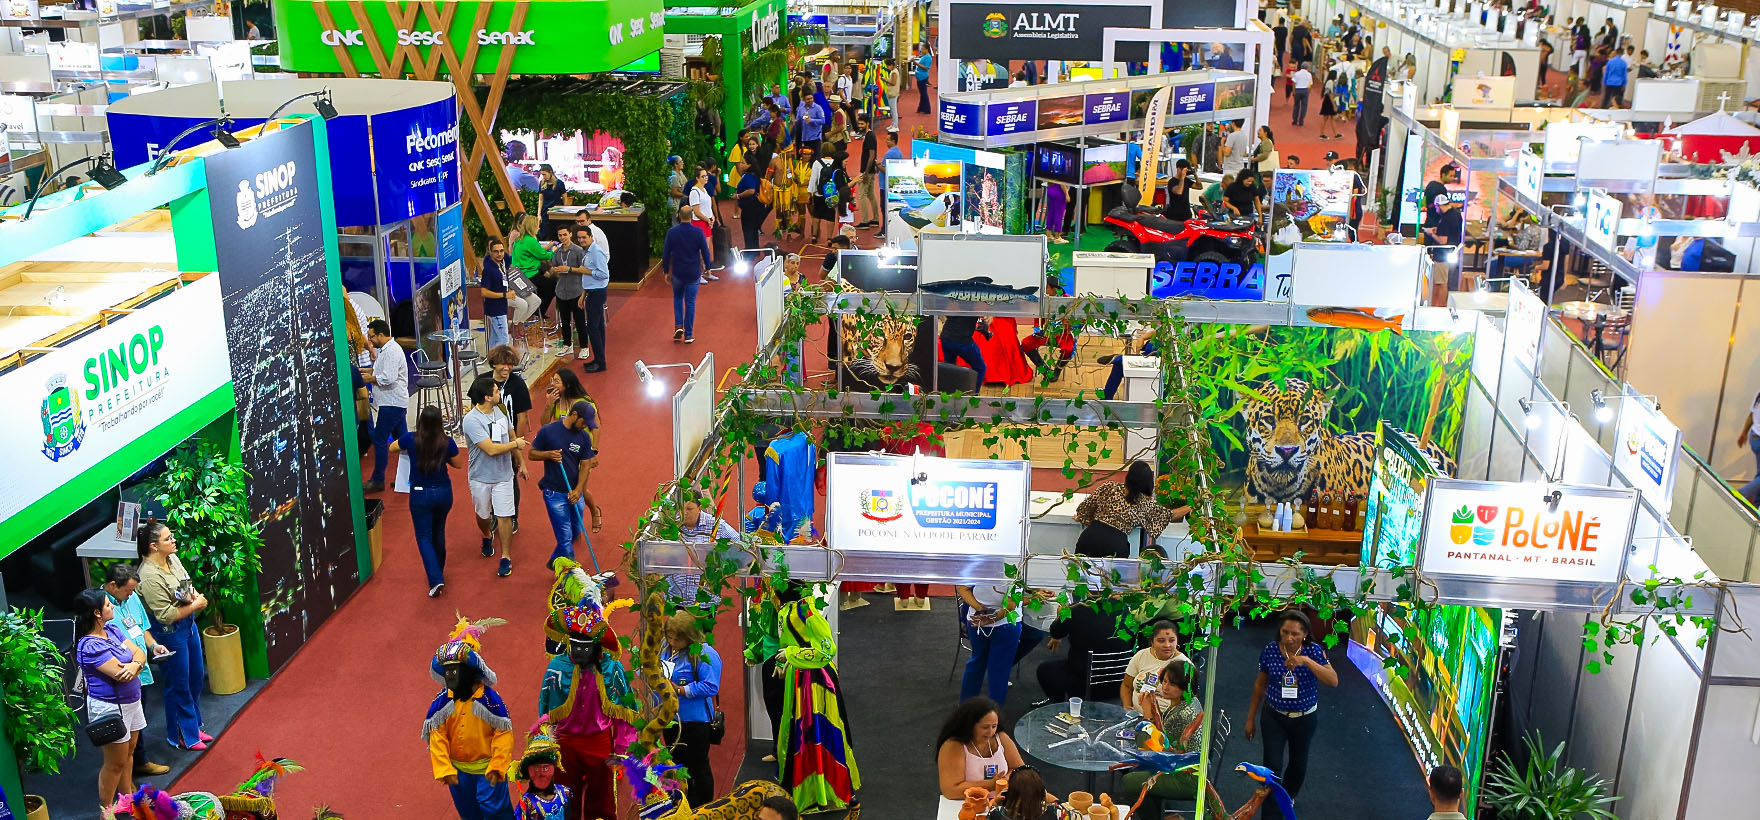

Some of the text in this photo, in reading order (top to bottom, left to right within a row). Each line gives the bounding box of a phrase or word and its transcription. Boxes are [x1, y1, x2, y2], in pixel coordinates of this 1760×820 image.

[1013, 12, 1080, 31] ALMT
[321, 28, 536, 46] CNC Sesc Senac
[609, 22, 624, 46] CNC
[630, 18, 645, 38] Sesc
[1013, 31, 1079, 40] Assembleia Legislativa
[966, 74, 994, 84] ALMT
[1179, 93, 1207, 105] SEBRAE
[1092, 102, 1122, 114] SEBRAE
[995, 112, 1028, 125] SEBRAE
[6, 122, 24, 130] ravel
[408, 160, 425, 172] CNC
[255, 161, 296, 199] SINOP
[258, 186, 298, 211] PREFEITURA
[84, 324, 164, 401] SINOP
[88, 367, 170, 422] PREFEITURA
[911, 483, 996, 510] POCONÉ
[915, 509, 992, 519] PREFEITURA MUNICIPAL
[925, 517, 952, 525] GESTÃO
[1447, 551, 1596, 567] PANTANAL MT BRASIL
